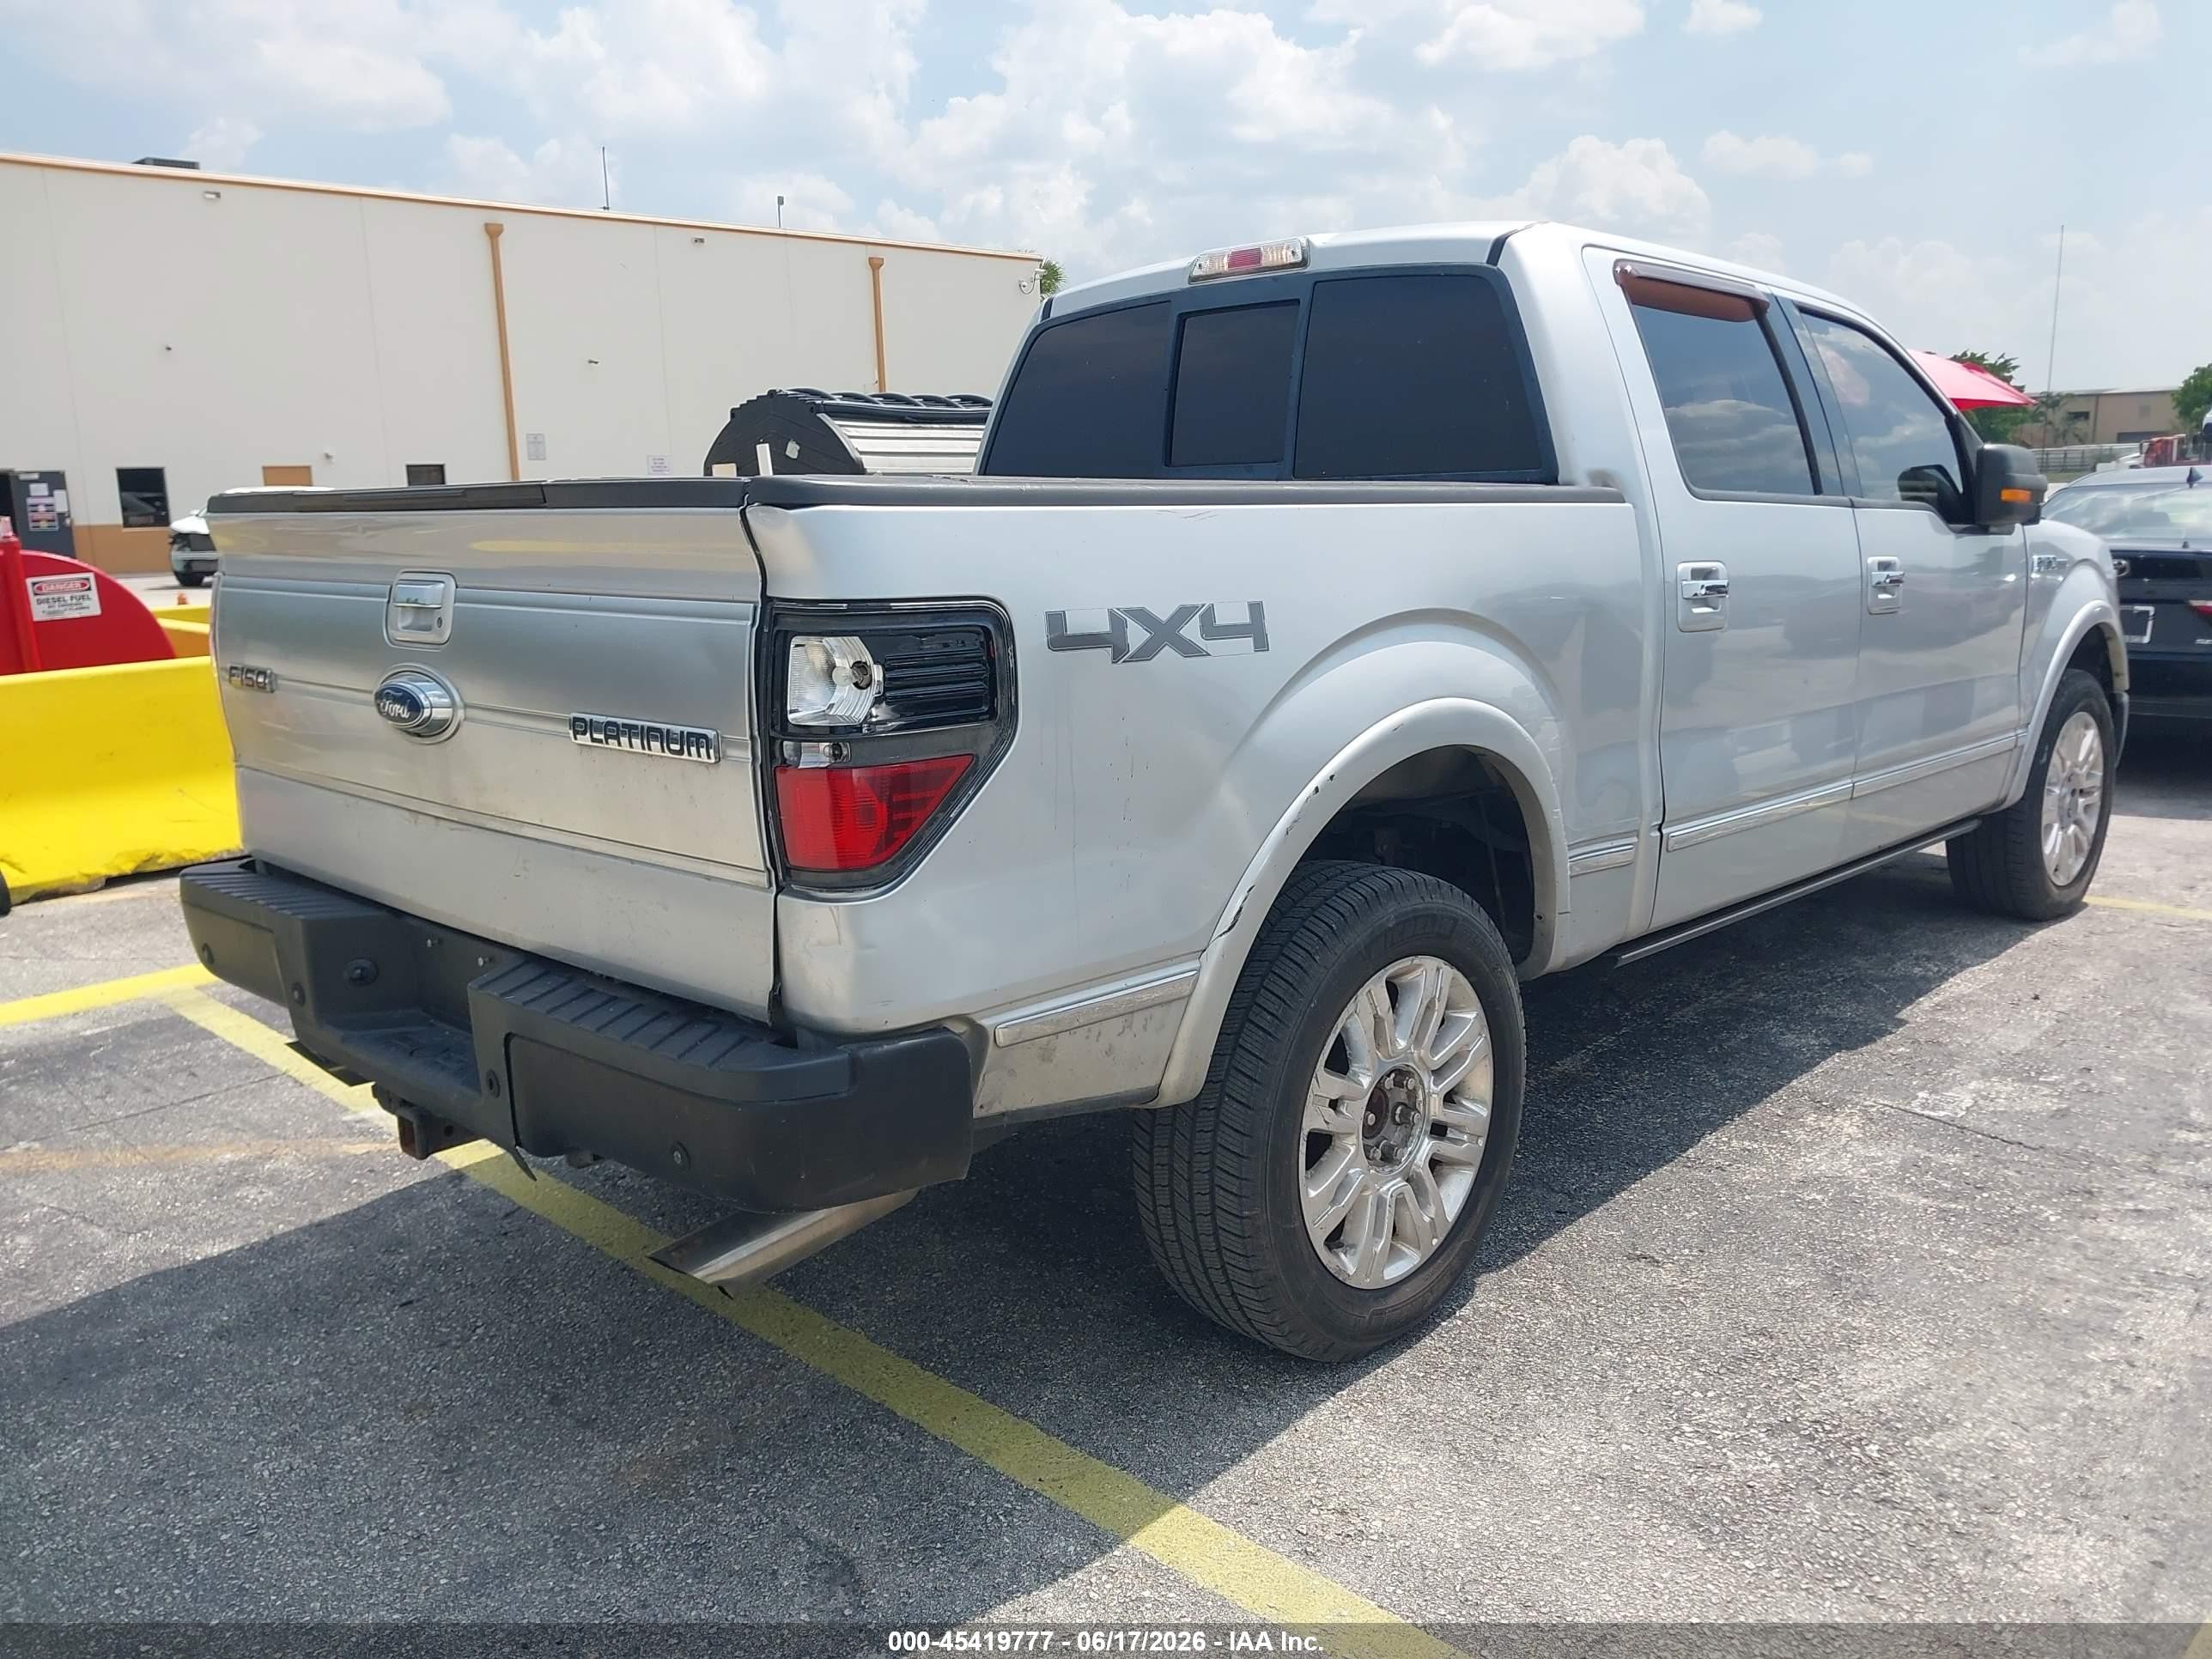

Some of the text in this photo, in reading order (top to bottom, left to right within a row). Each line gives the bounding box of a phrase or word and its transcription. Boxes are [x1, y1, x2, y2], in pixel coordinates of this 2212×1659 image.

[41, 581, 82, 592] DANGER
[36, 593, 91, 605] DIESEL FUEL
[379, 689, 411, 720] Ford
[570, 715, 711, 760] PLATINUM
